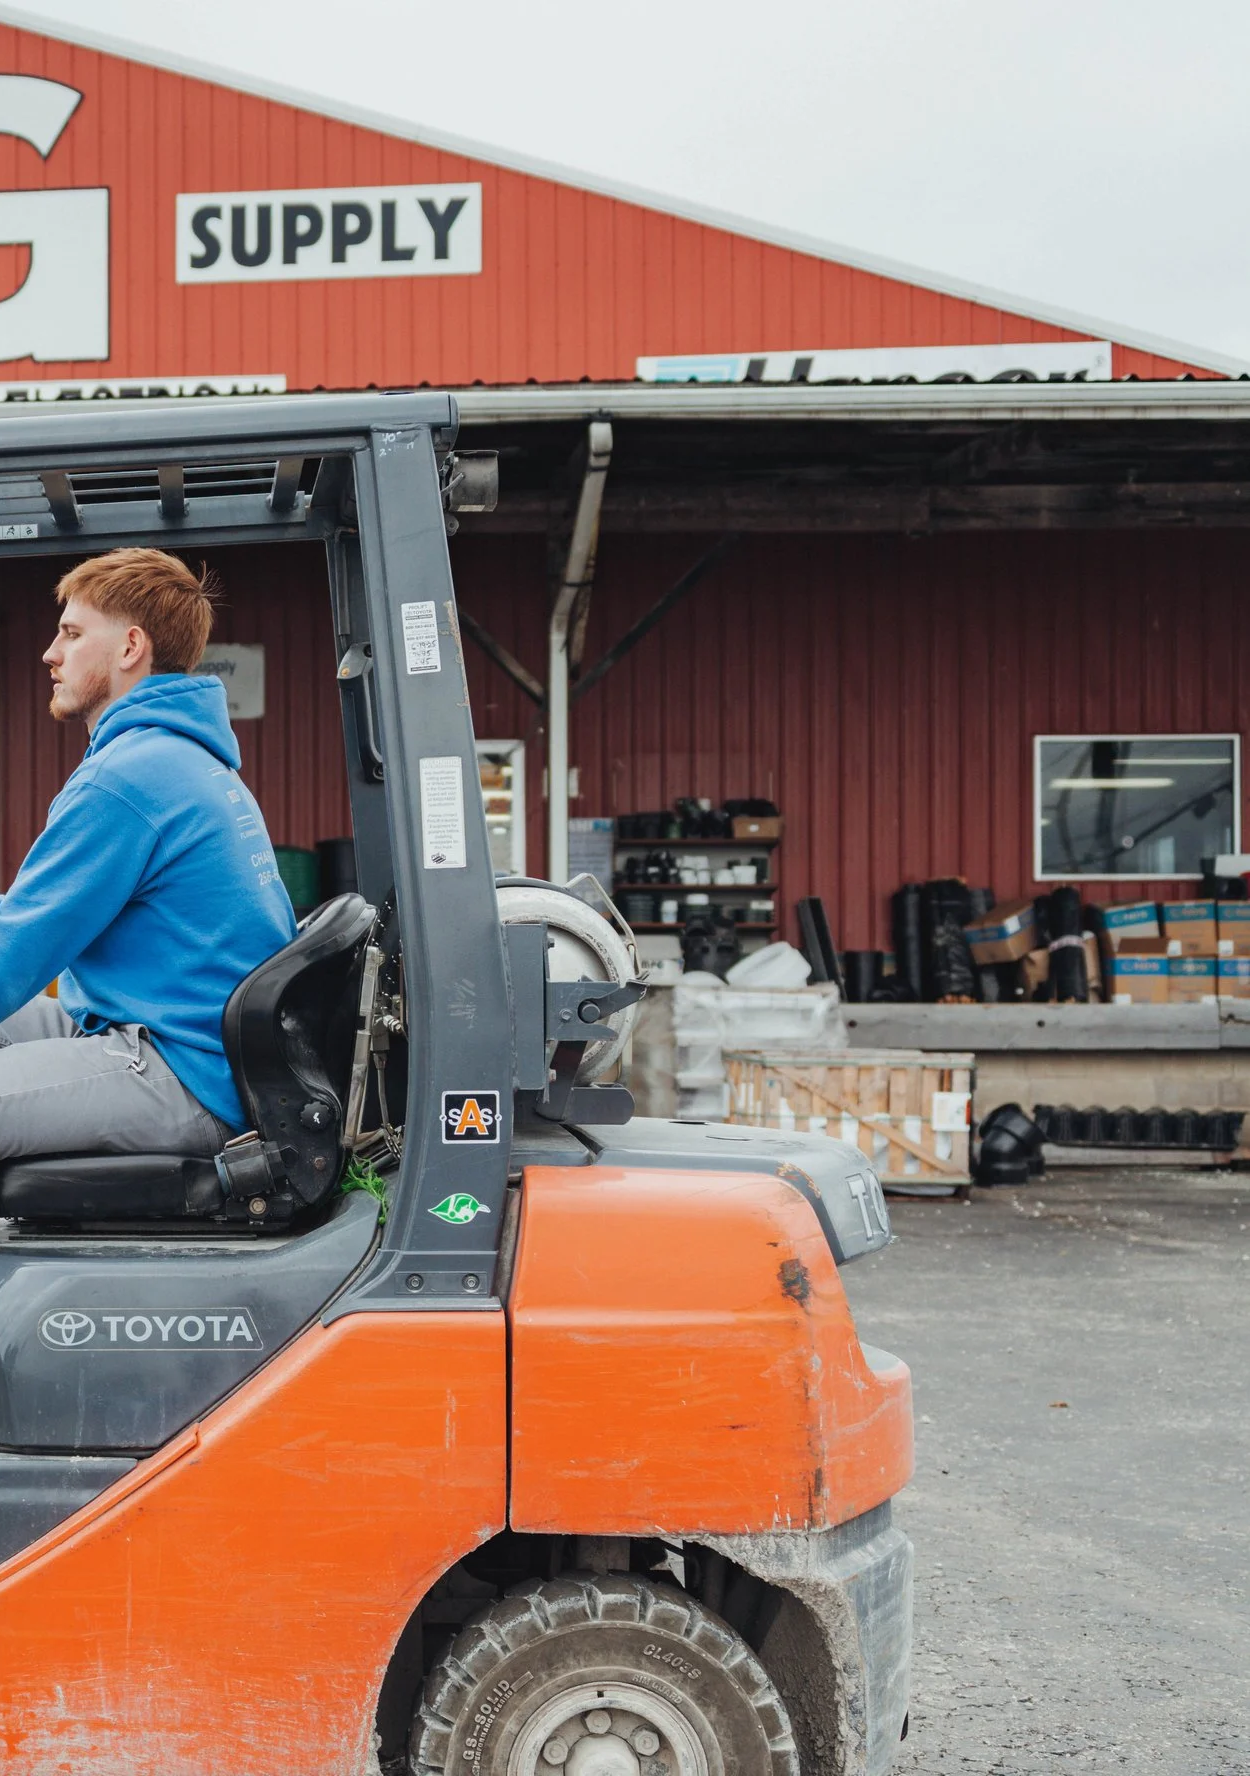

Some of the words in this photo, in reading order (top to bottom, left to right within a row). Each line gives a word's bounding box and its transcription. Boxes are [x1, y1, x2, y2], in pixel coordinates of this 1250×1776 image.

[190, 197, 469, 270] SUPPLY
[102, 1316, 253, 1341] TOYOTA
[643, 1644, 702, 1680] CL403S
[652, 1682, 683, 1704] GUARD
